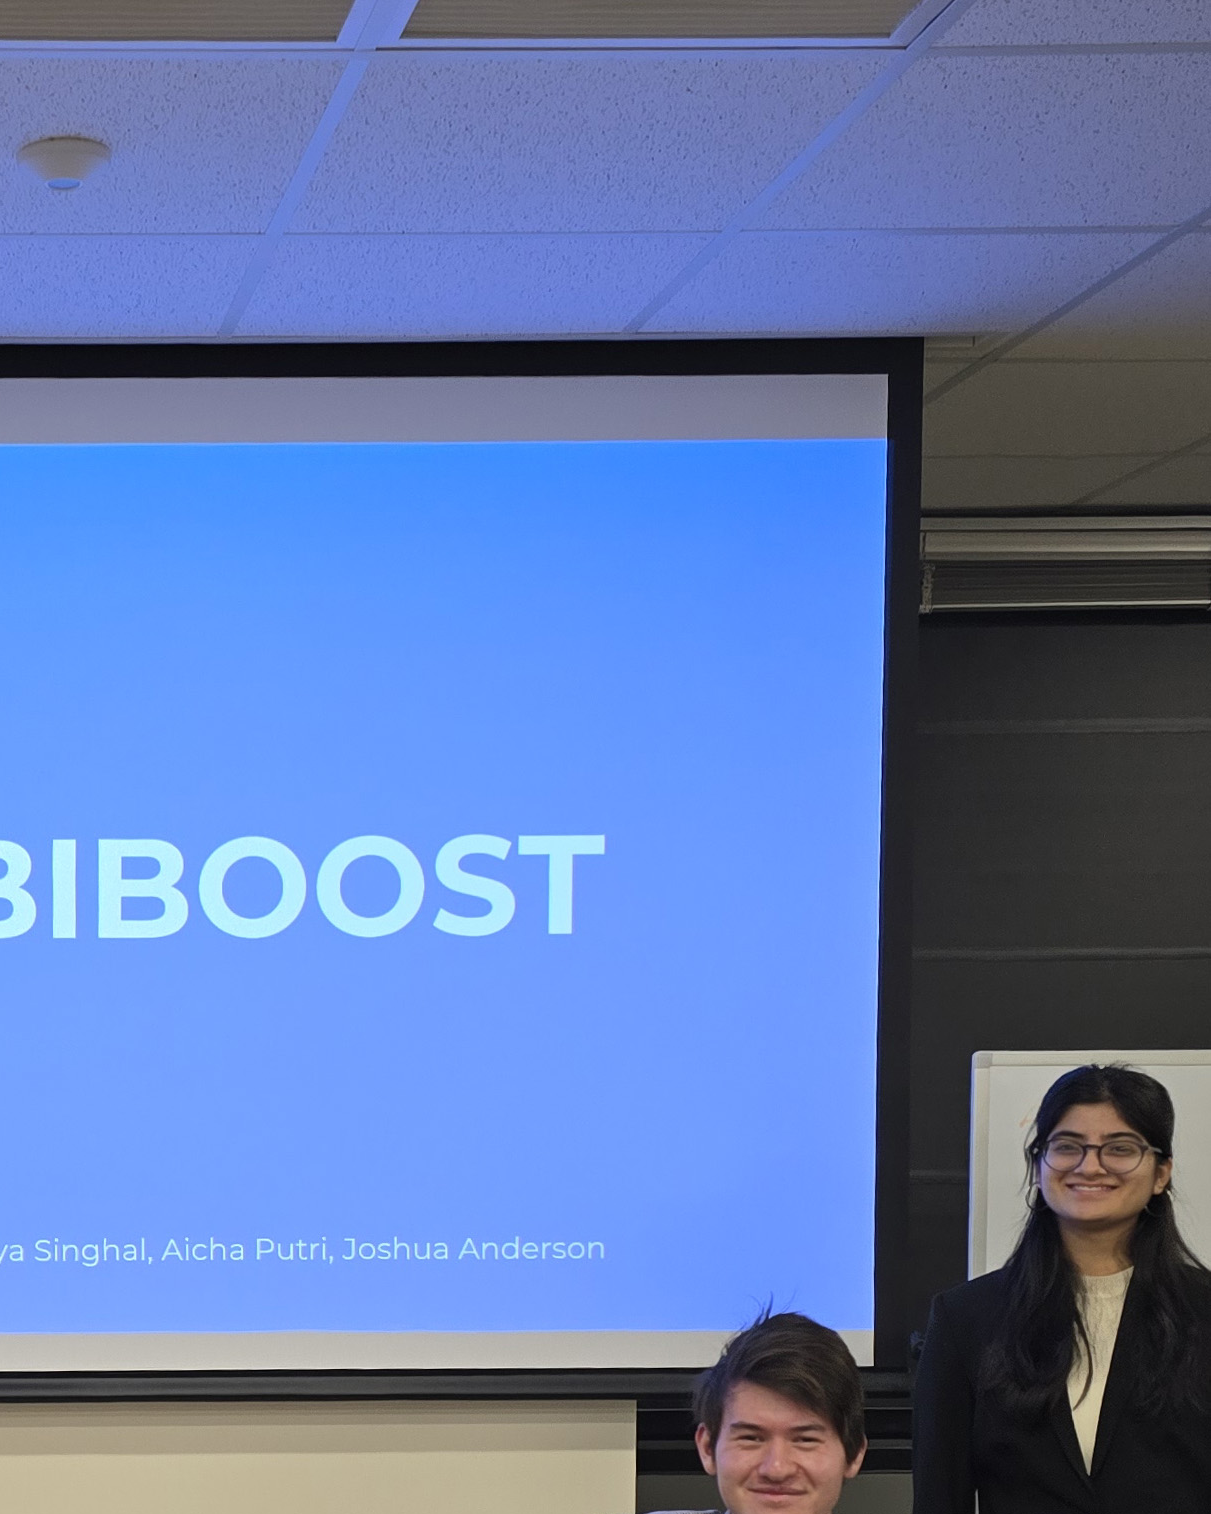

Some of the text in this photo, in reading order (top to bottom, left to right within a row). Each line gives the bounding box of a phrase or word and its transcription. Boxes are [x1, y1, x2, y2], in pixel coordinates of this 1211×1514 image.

[35, 1237, 154, 1268] Singhal,
[161, 1236, 245, 1262] Aicha
[256, 1236, 334, 1265] Putri,
[342, 1236, 449, 1261] Joshua
[458, 1236, 605, 1260] Anderson
